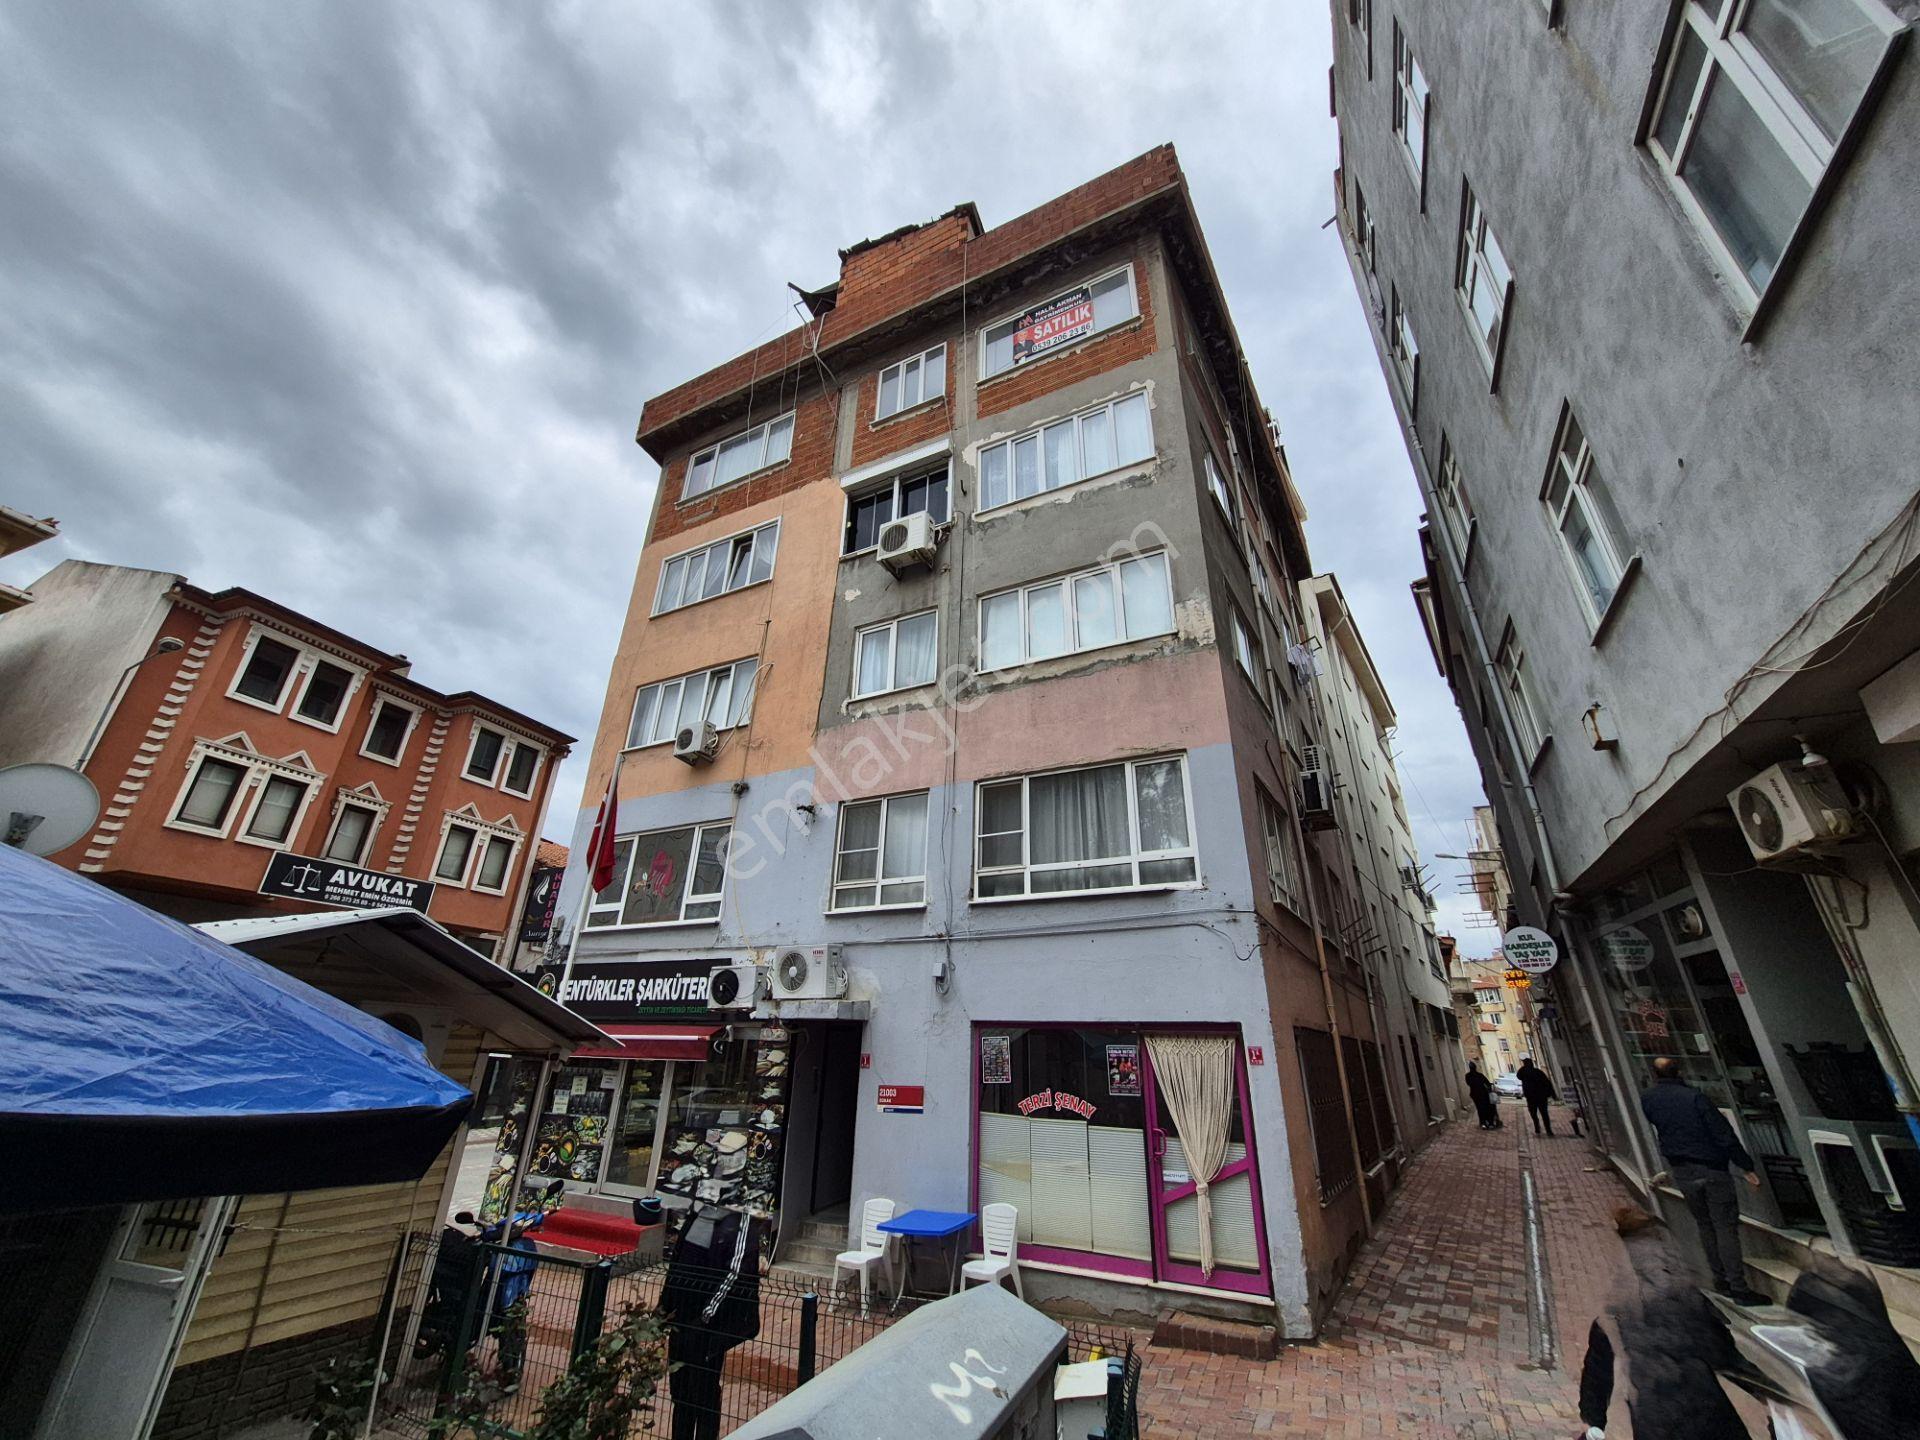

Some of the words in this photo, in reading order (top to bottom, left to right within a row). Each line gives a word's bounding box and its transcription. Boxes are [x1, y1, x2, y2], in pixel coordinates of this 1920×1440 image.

[1035, 304, 1055, 317] HALİL
[1056, 293, 1083, 308] AKMAN
[1033, 304, 1092, 340] SATILIK
[1052, 333, 1068, 344] 206
[1069, 327, 1079, 338] 23
[328, 869, 418, 898] AVUKAT
[325, 886, 360, 897] MEHMET
[360, 891, 380, 901] EMİN
[380, 895, 413, 906] ÖZDEMİR
[1504, 941, 1554, 951] KARDEŞLER
[1517, 934, 1536, 942] KUL
[1512, 951, 1530, 959] TAŞ
[879, 1088, 897, 1097] 21003
[1018, 1087, 1053, 1116] TERZİ
[1054, 1092, 1097, 1120] ŞENAY
